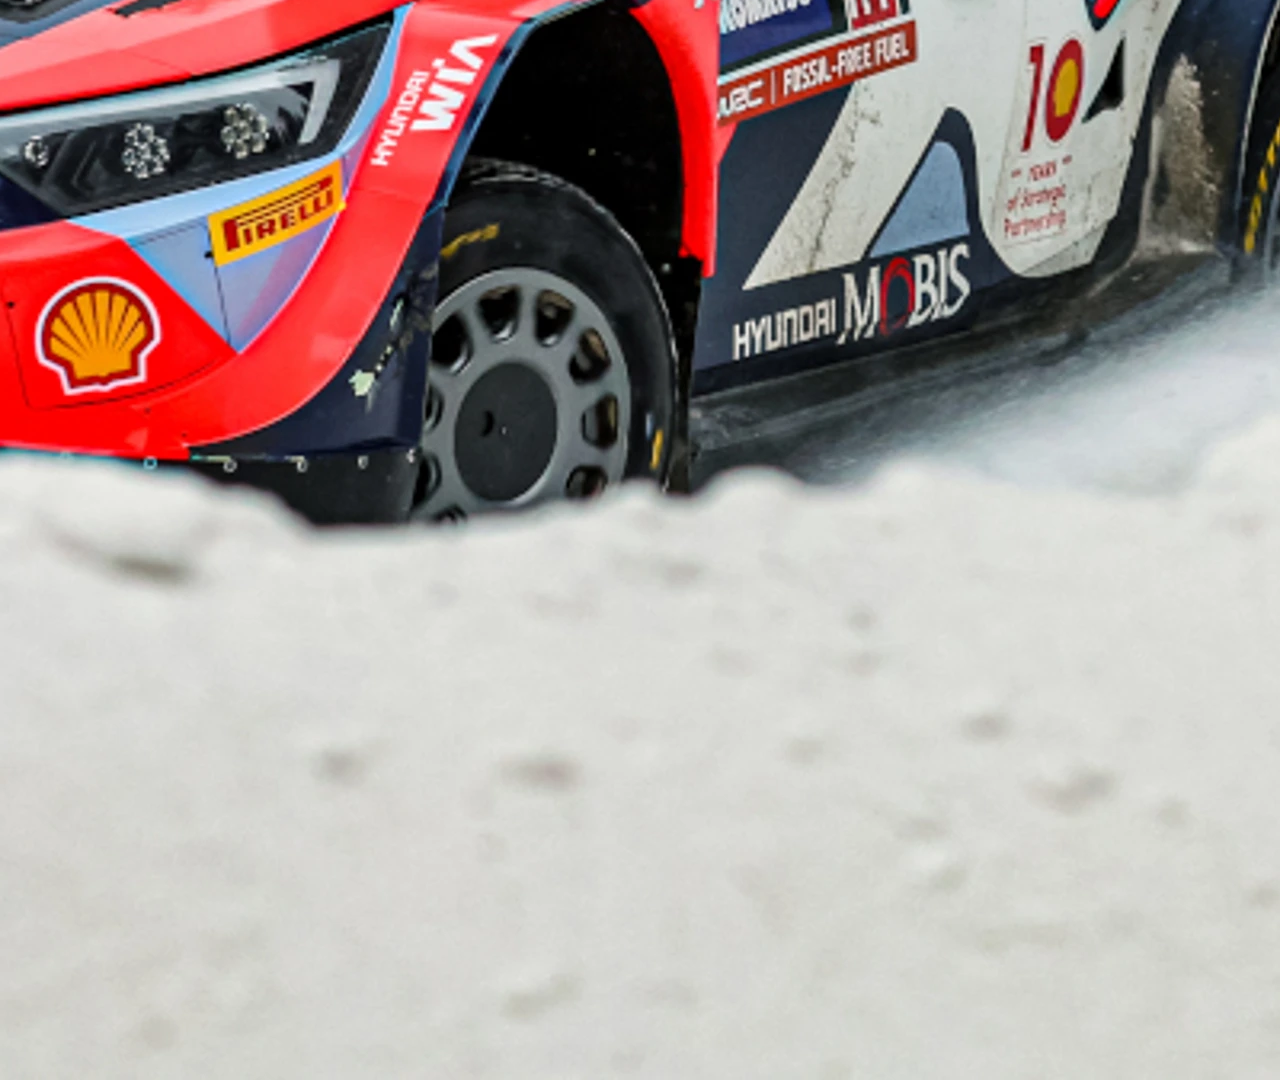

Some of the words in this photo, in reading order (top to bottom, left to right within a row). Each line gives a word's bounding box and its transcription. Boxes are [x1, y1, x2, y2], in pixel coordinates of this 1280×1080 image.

[409, 33, 500, 131] WIA
[875, 31, 910, 65] FUEL
[370, 70, 431, 166] HYUNDAI
[222, 174, 334, 252] PIRELLI
[731, 296, 837, 362] HYUNDAI
[835, 241, 971, 347] MOBIS
